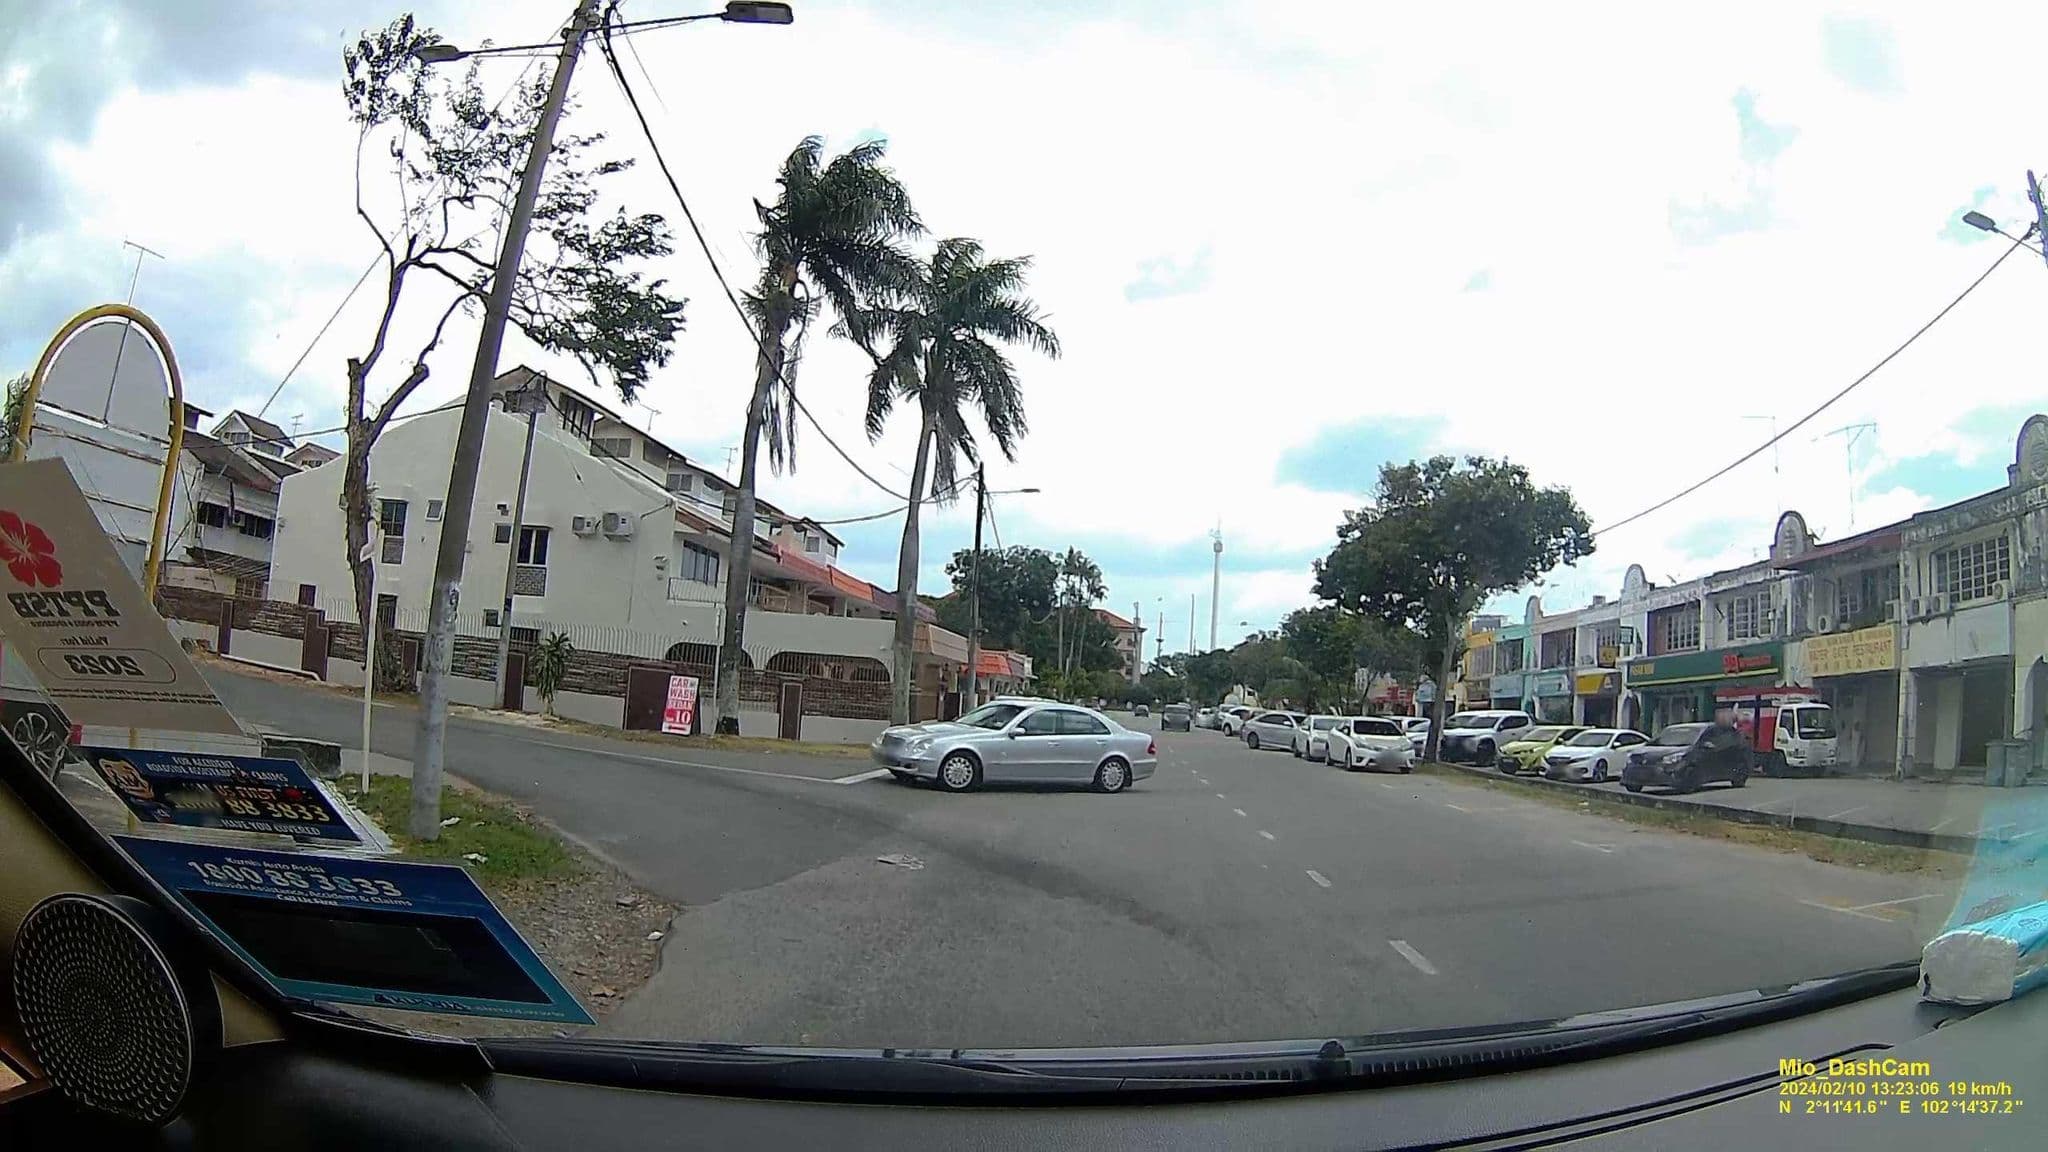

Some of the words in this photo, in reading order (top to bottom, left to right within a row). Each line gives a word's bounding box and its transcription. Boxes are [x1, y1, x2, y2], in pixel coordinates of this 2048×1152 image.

[671, 678, 689, 688] CAR
[670, 688, 696, 699] WASH
[676, 711, 691, 724] 10
[266, 802, 330, 822] 3833
[250, 821, 274, 833] YOU
[188, 861, 263, 884] 1800
[264, 869, 309, 889] 88
[310, 874, 402, 897] 3833
[370, 896, 412, 907] Claims
